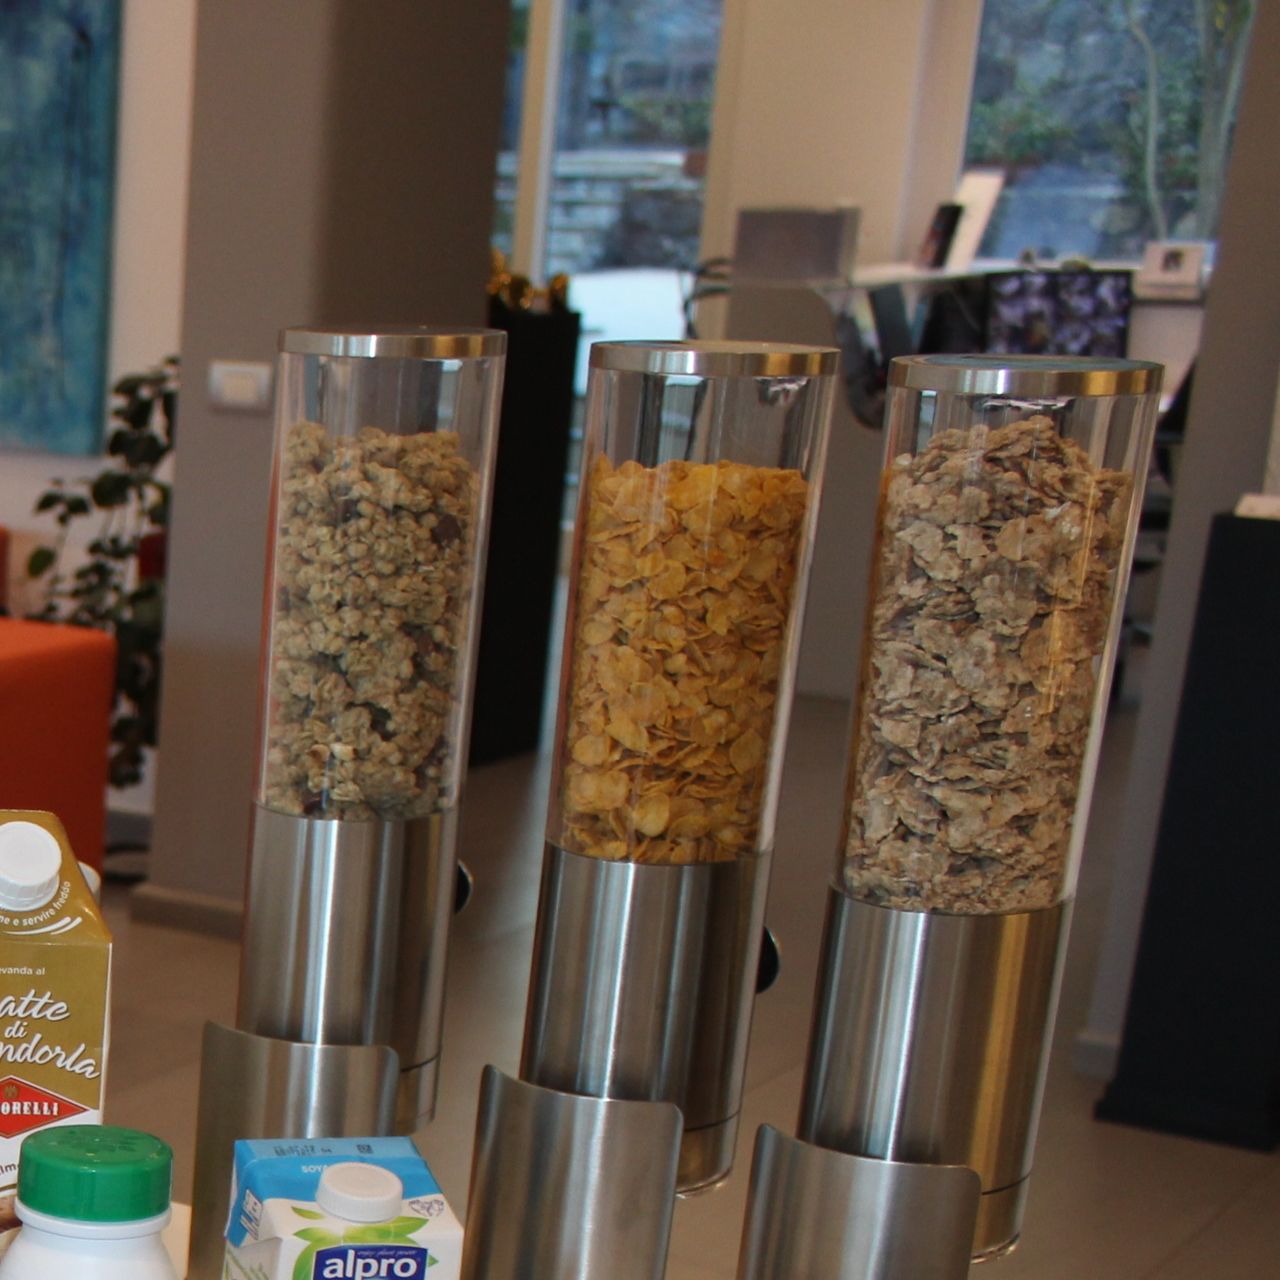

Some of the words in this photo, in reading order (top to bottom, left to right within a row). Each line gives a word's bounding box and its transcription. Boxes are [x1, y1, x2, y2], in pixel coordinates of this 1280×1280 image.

[22, 909, 56, 926] servire
[53, 881, 71, 912] freddo
[35, 966, 46, 975] al
[4, 1021, 28, 1039] di
